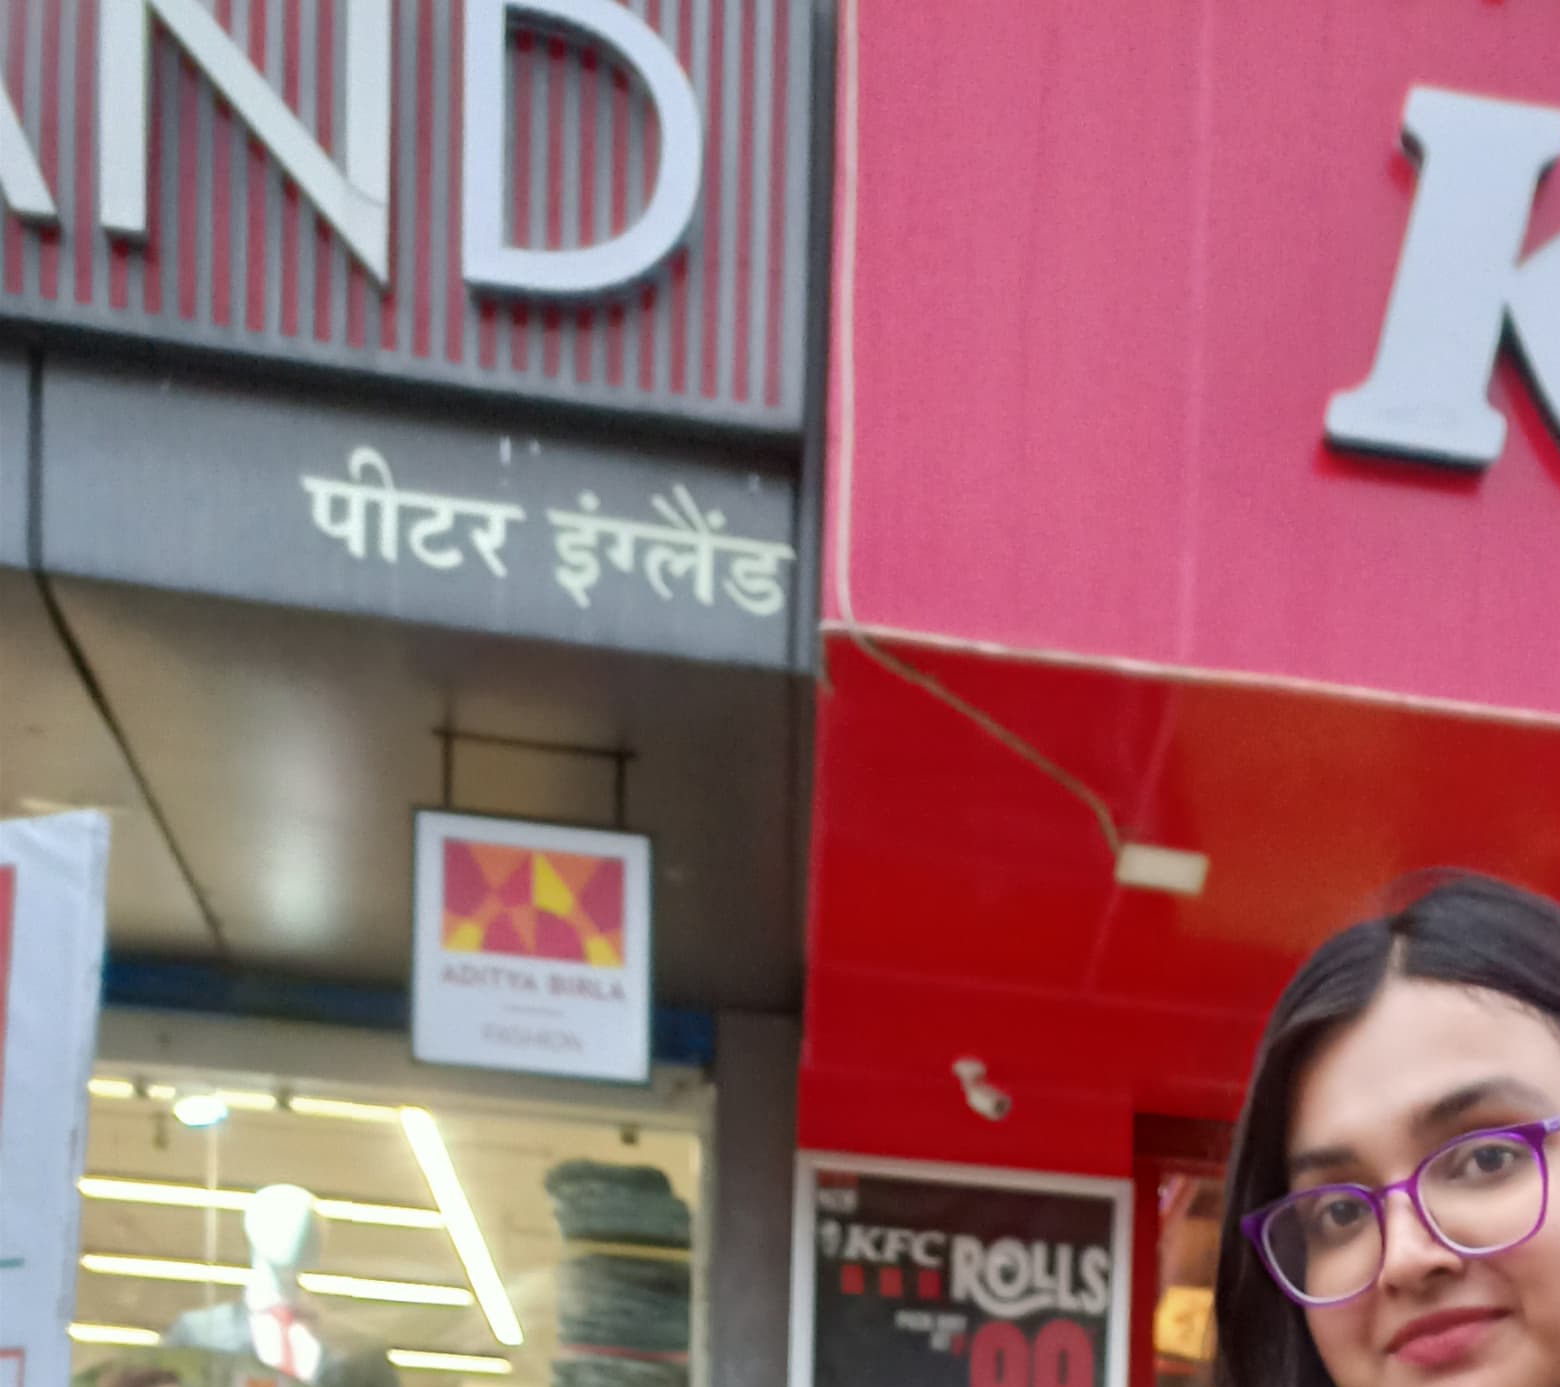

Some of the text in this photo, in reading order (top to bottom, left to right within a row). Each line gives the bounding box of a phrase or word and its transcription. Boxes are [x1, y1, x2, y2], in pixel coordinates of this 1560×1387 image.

[301, 447, 796, 617] पीटर इंग्लैंड
[441, 963, 627, 1001] ADITYA BIRLA
[844, 1221, 1112, 1319] KFC ROLLS
